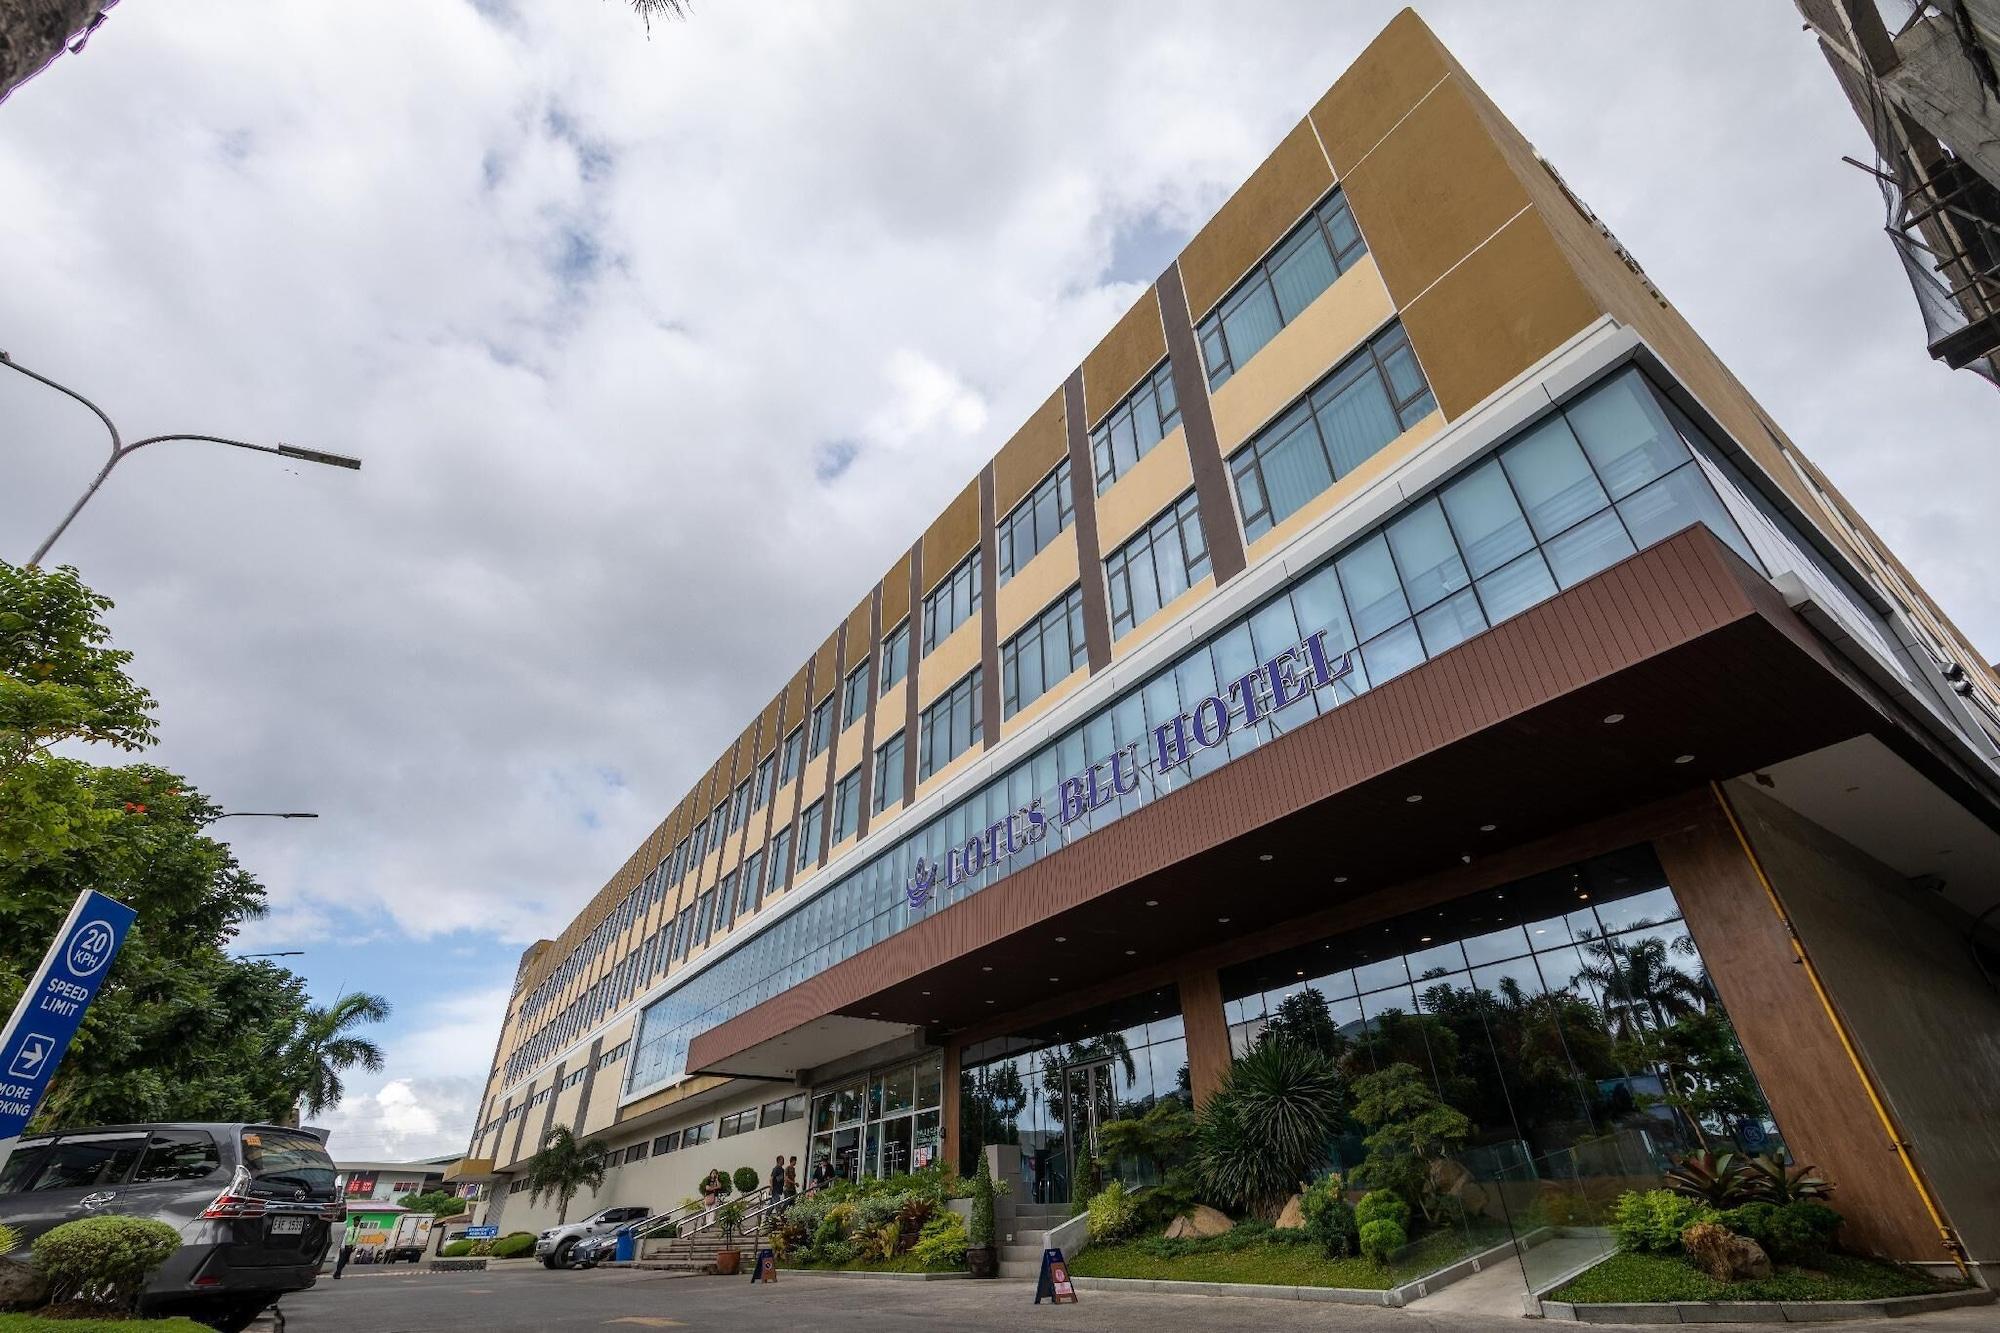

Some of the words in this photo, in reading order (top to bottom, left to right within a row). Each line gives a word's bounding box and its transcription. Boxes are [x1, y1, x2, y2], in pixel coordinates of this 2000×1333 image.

[944, 797, 1047, 889] LOTUS
[1059, 742, 1139, 826] BLU
[1152, 628, 1353, 775] HOTEL
[81, 928, 108, 953] 20
[73, 949, 99, 968] KPH
[47, 978, 89, 1002] SPEED
[40, 995, 79, 1017] LIMIT
